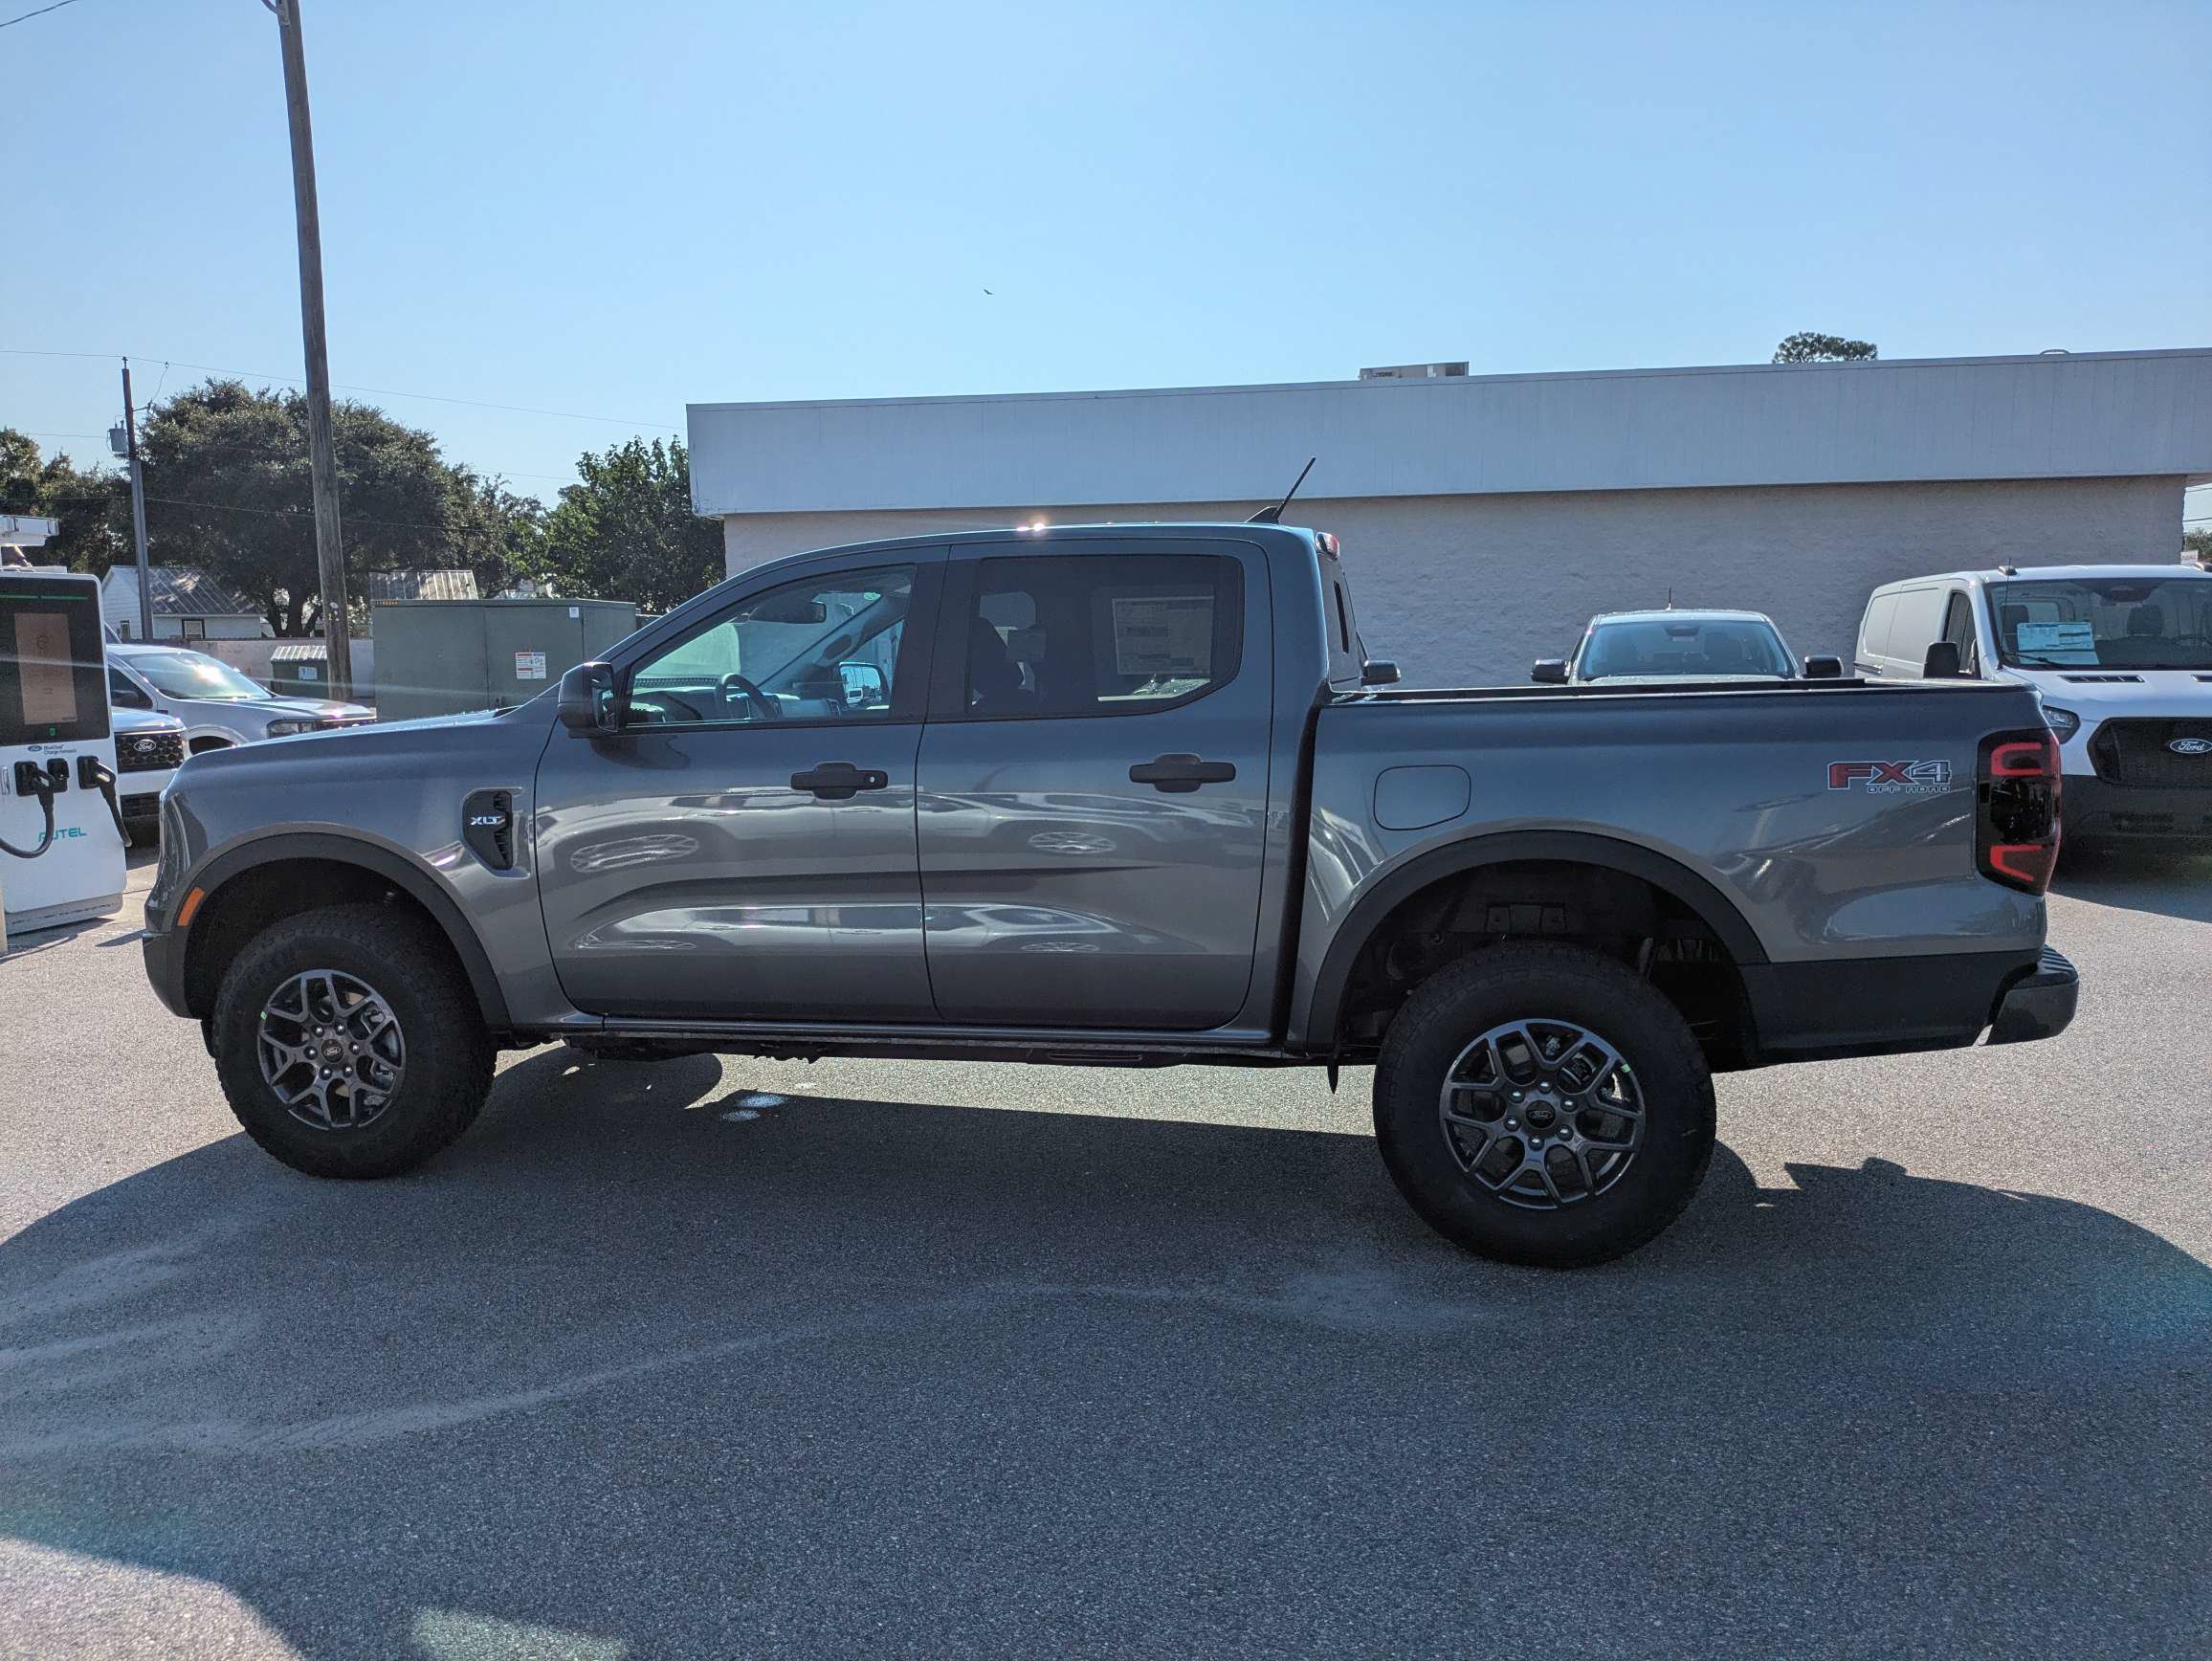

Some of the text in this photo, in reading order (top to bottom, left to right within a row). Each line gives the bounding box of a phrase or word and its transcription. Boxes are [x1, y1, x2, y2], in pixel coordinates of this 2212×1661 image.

[2179, 741, 2205, 751] Ford
[1827, 761, 1952, 790] FX4
[1867, 785, 1951, 793] OFF ROAD
[470, 816, 501, 826] XLT
